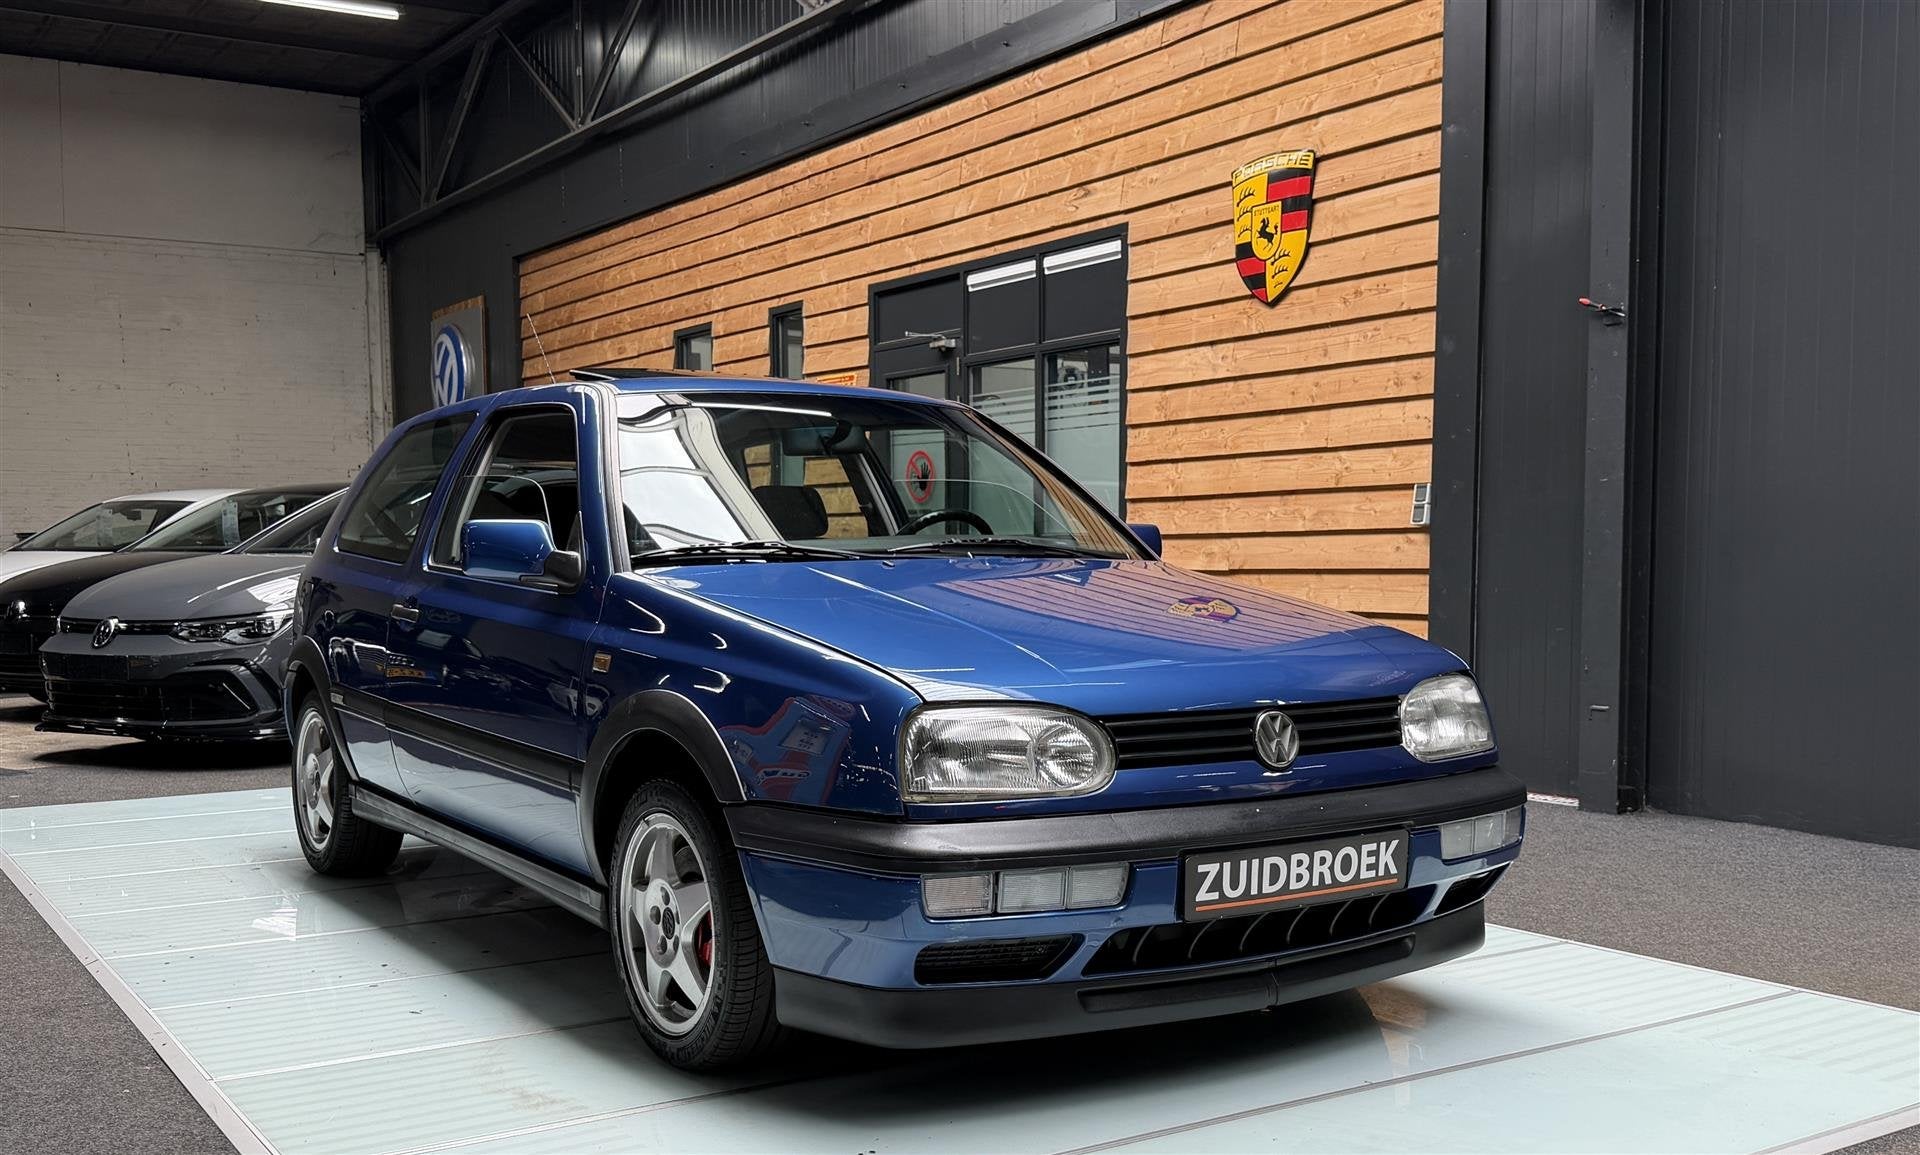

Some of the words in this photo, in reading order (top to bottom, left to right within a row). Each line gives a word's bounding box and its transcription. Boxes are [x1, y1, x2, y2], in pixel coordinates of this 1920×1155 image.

[1234, 154, 1311, 184] PORSCHE
[1254, 205, 1280, 216] STUTTGART
[1195, 839, 1400, 902] ZUIDBROEK
